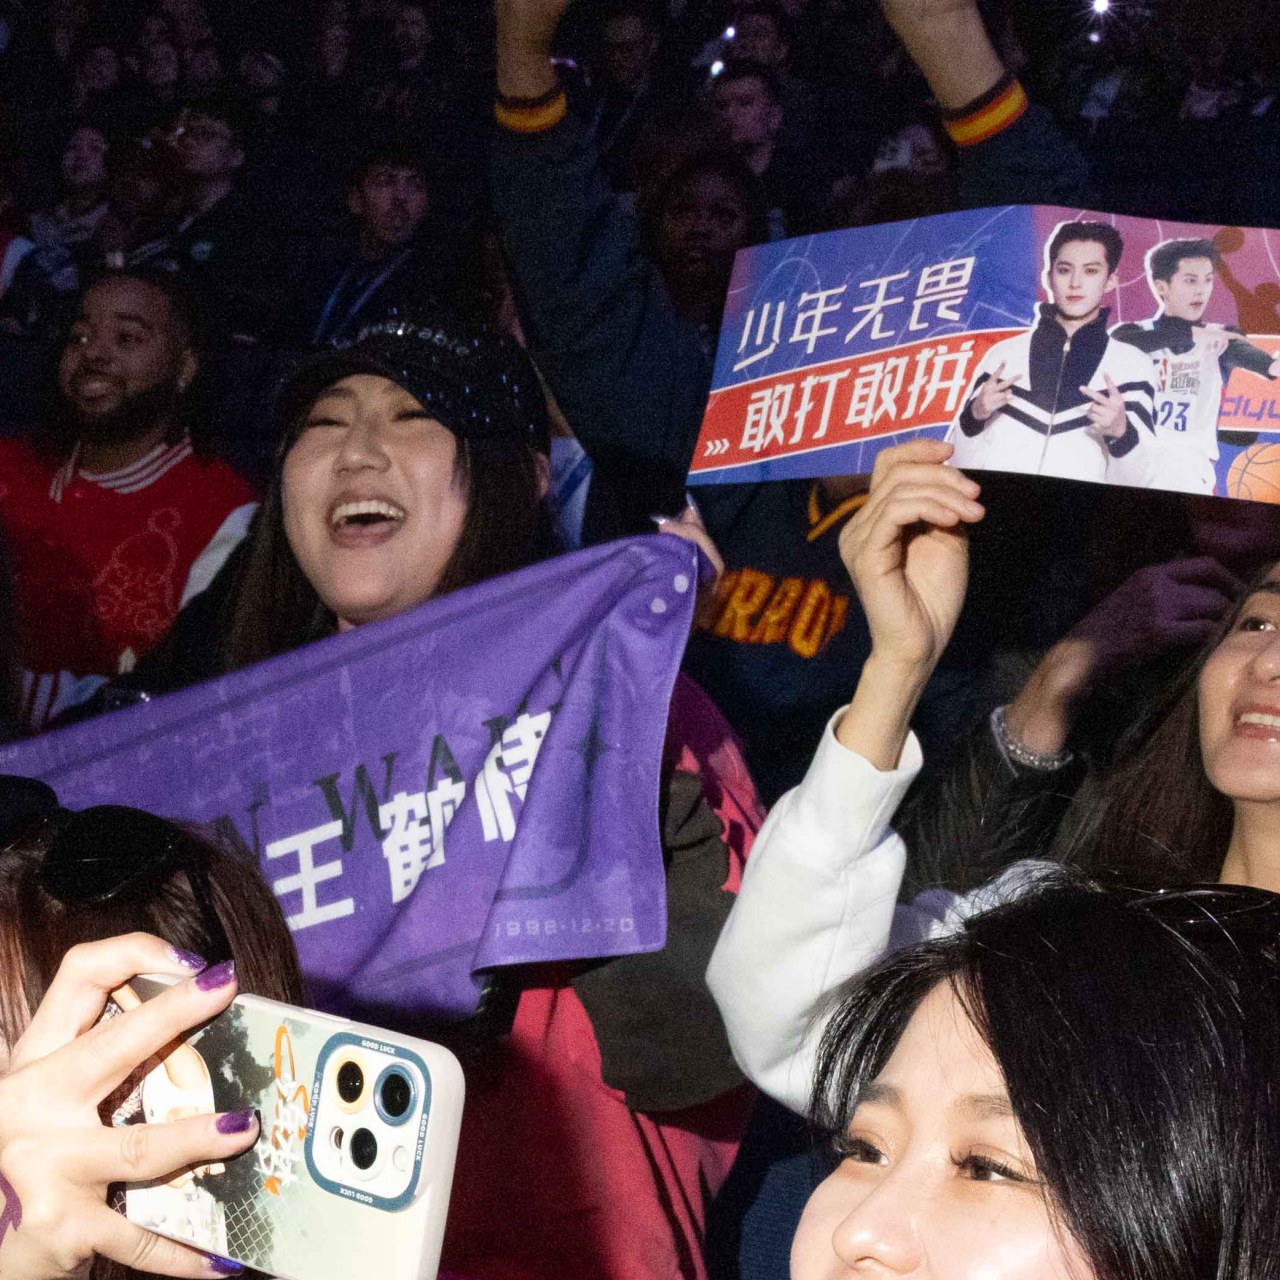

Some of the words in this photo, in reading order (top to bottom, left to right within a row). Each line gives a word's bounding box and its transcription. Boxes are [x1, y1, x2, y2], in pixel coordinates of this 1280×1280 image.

[733, 255, 976, 372] 少年无畏
[739, 340, 975, 453] 敢打敢拼
[1160, 400, 1191, 432] 23
[361, 1040, 379, 1052] GOOD
[380, 1043, 396, 1055] LUCK
